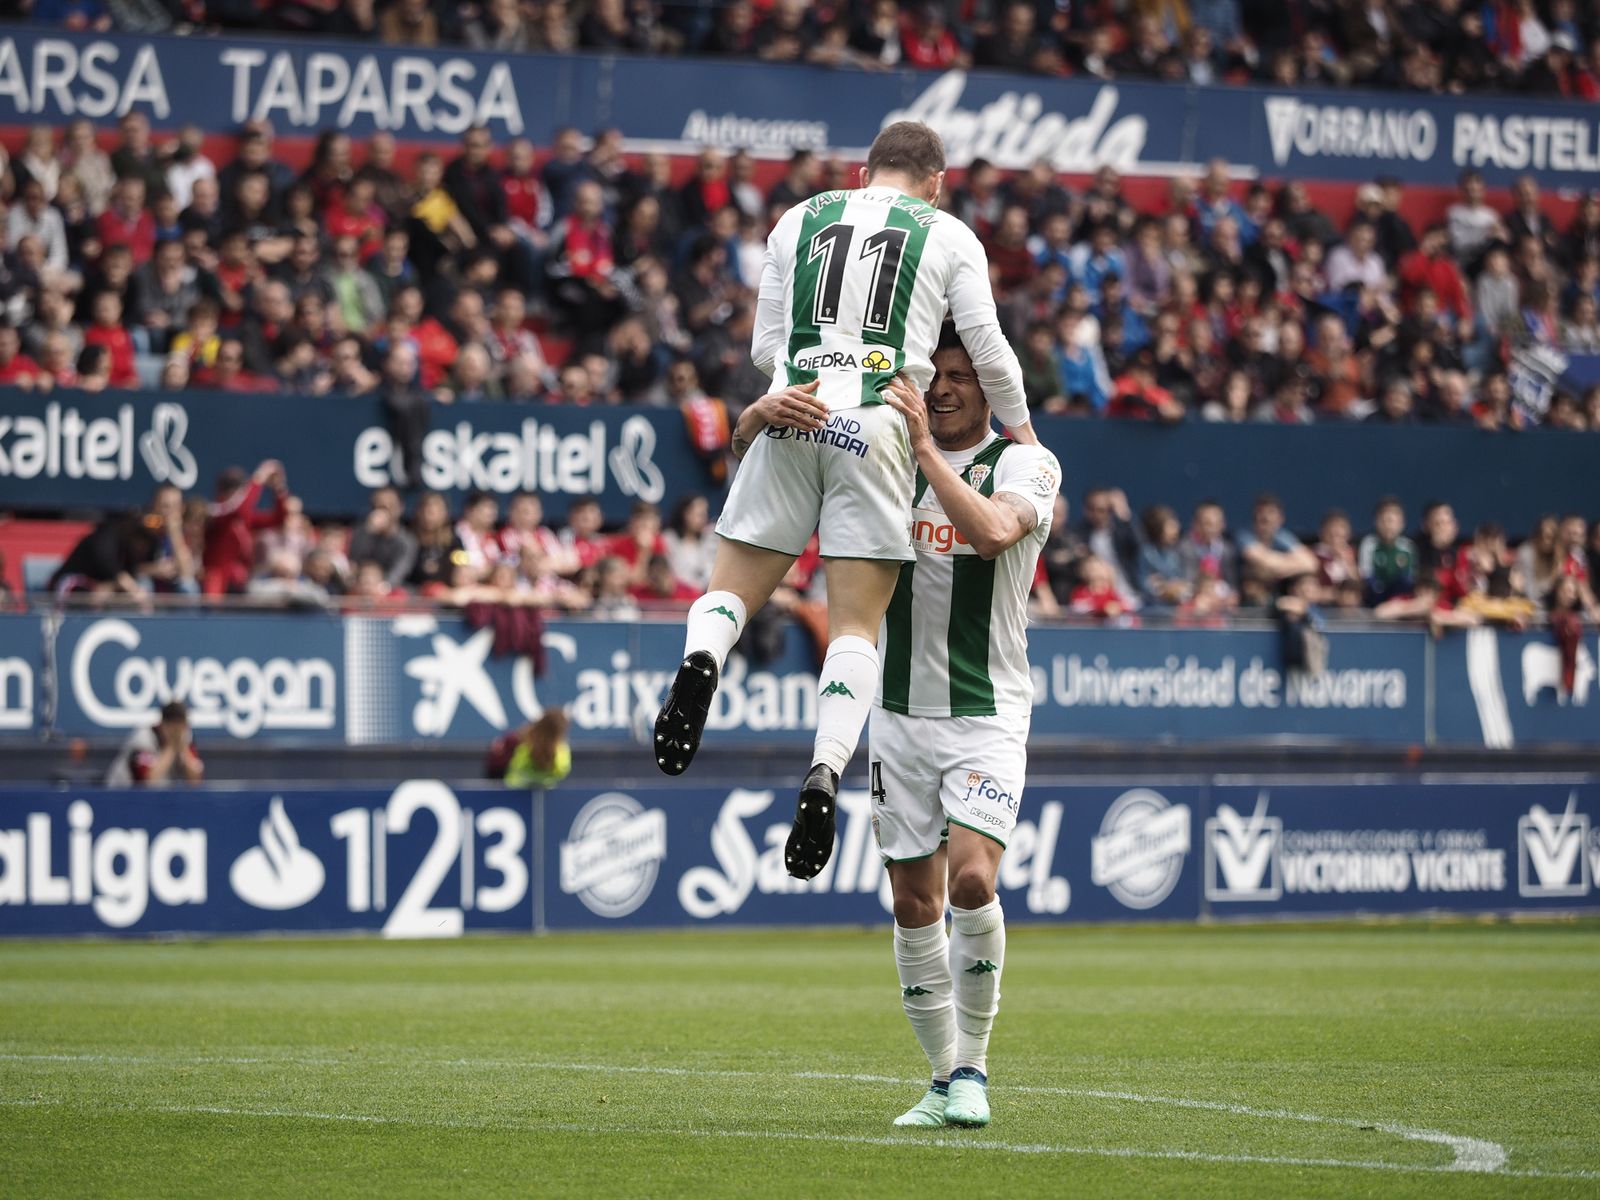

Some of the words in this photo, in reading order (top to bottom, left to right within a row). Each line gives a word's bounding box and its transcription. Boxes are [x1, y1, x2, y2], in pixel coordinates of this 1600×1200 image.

[219, 48, 525, 136] TAPARSA
[679, 109, 828, 151] Autocares
[1452, 111, 1600, 172] PASTEL
[807, 221, 911, 335] 11
[825, 414, 861, 435] UND
[512, 633, 820, 732] CaixBan
[1052, 654, 1236, 708] Universidad
[1238, 656, 1281, 708] de
[970, 807, 1006, 829] Kappa
[1281, 850, 1411, 893] VICTORINO
[1411, 849, 1507, 893] VICENTE
